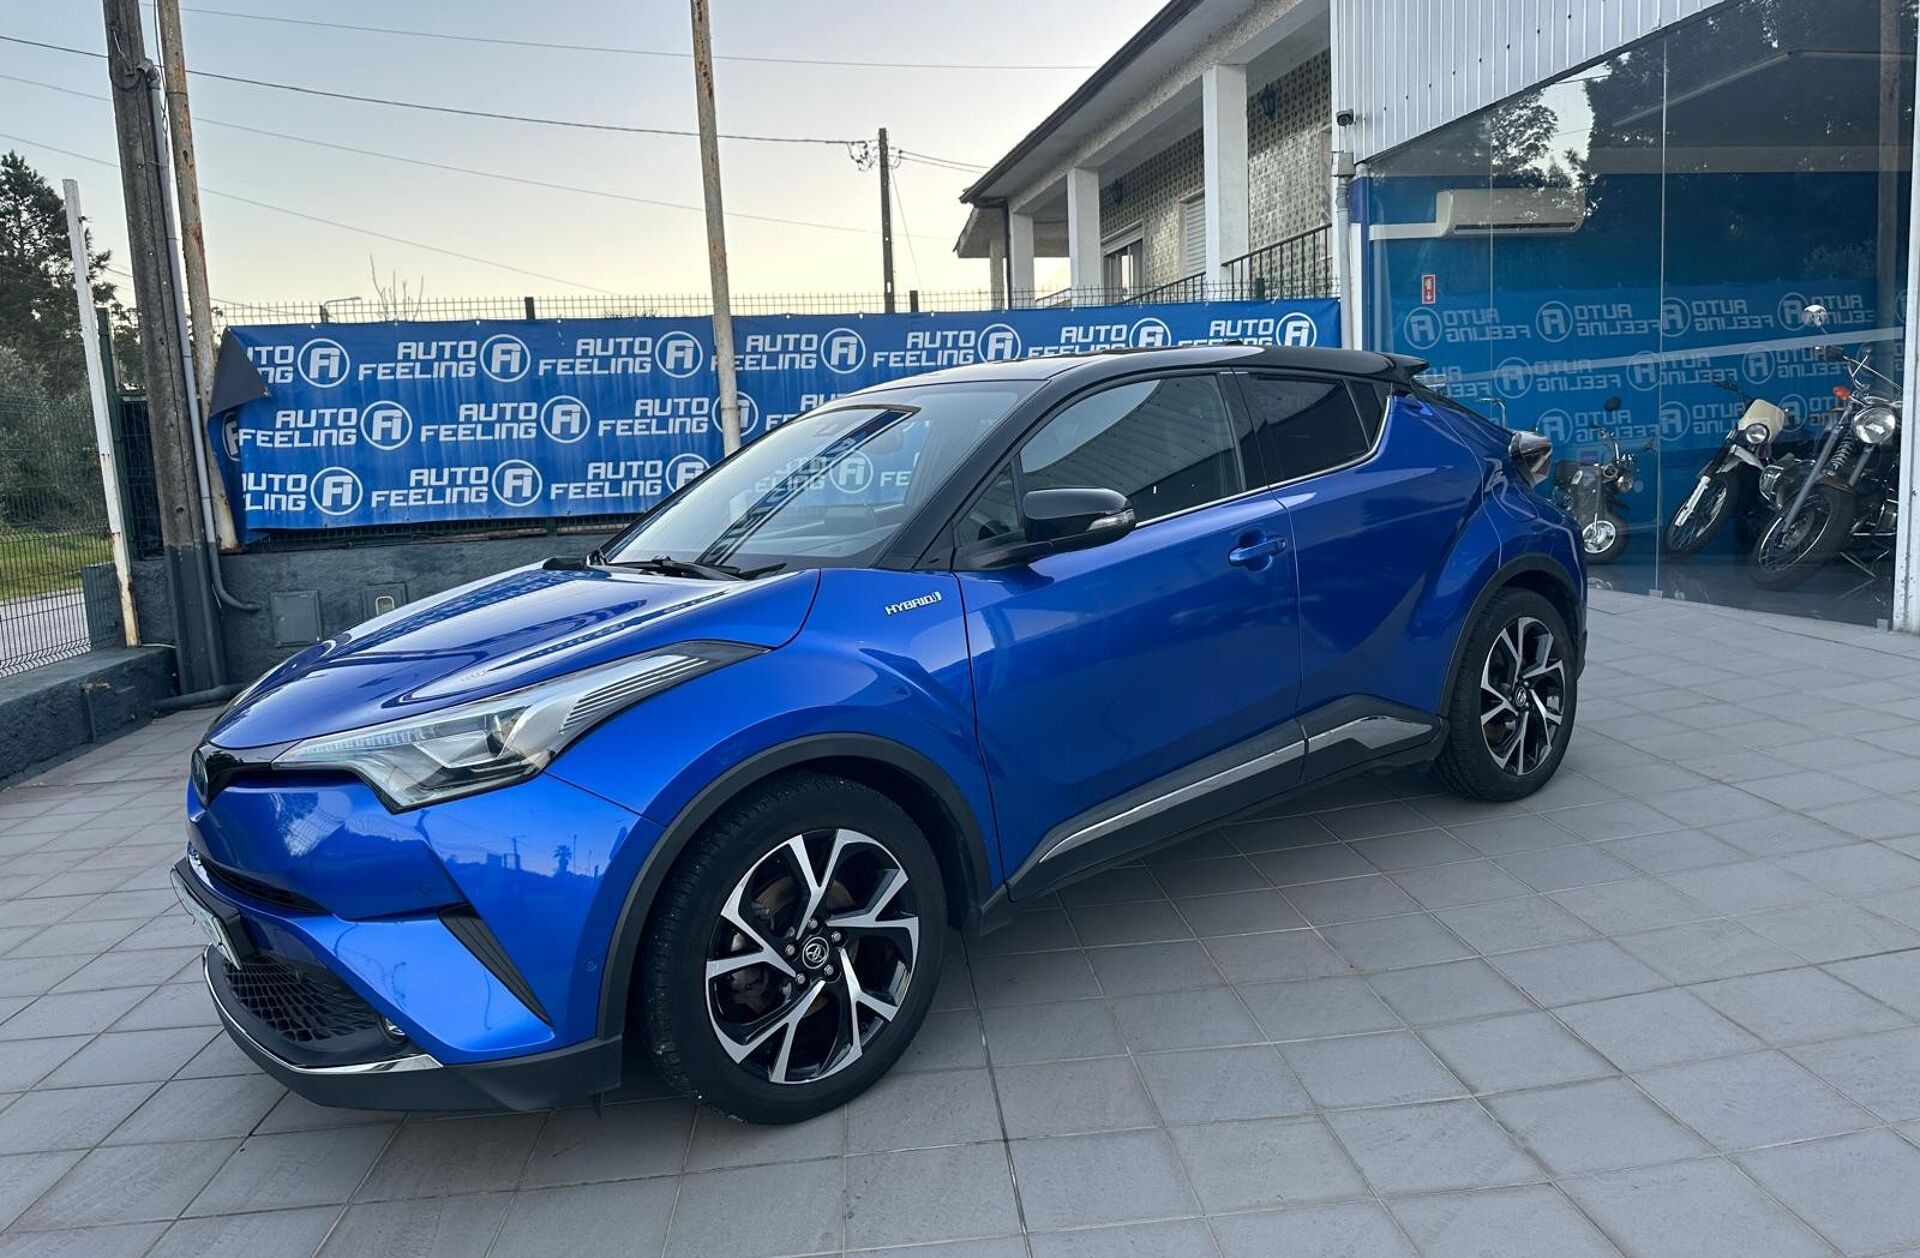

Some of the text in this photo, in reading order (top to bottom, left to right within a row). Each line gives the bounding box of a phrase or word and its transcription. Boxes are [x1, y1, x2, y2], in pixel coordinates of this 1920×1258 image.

[1060, 324, 1128, 343] AUTO
[1209, 319, 1275, 337] AUTO
[575, 337, 652, 356] AUTO
[745, 334, 818, 352] AUTO
[906, 330, 976, 349] AUTO
[397, 340, 477, 360] AUTO
[872, 349, 974, 368] FEELING
[358, 361, 476, 381] FEELING
[538, 357, 652, 376] FEELING
[459, 402, 538, 422] AUTO
[635, 397, 709, 417] AUTO
[275, 408, 358, 428] AUTO
[598, 417, 709, 437] FEELING
[238, 428, 357, 448] FEELING
[421, 422, 537, 442] FEELING
[409, 466, 489, 487] AUTO
[587, 460, 663, 480] AUTO
[242, 472, 308, 492] UTO
[550, 480, 662, 500] FEELING
[371, 486, 489, 508] FEELING
[885, 594, 934, 615] HYBRID
